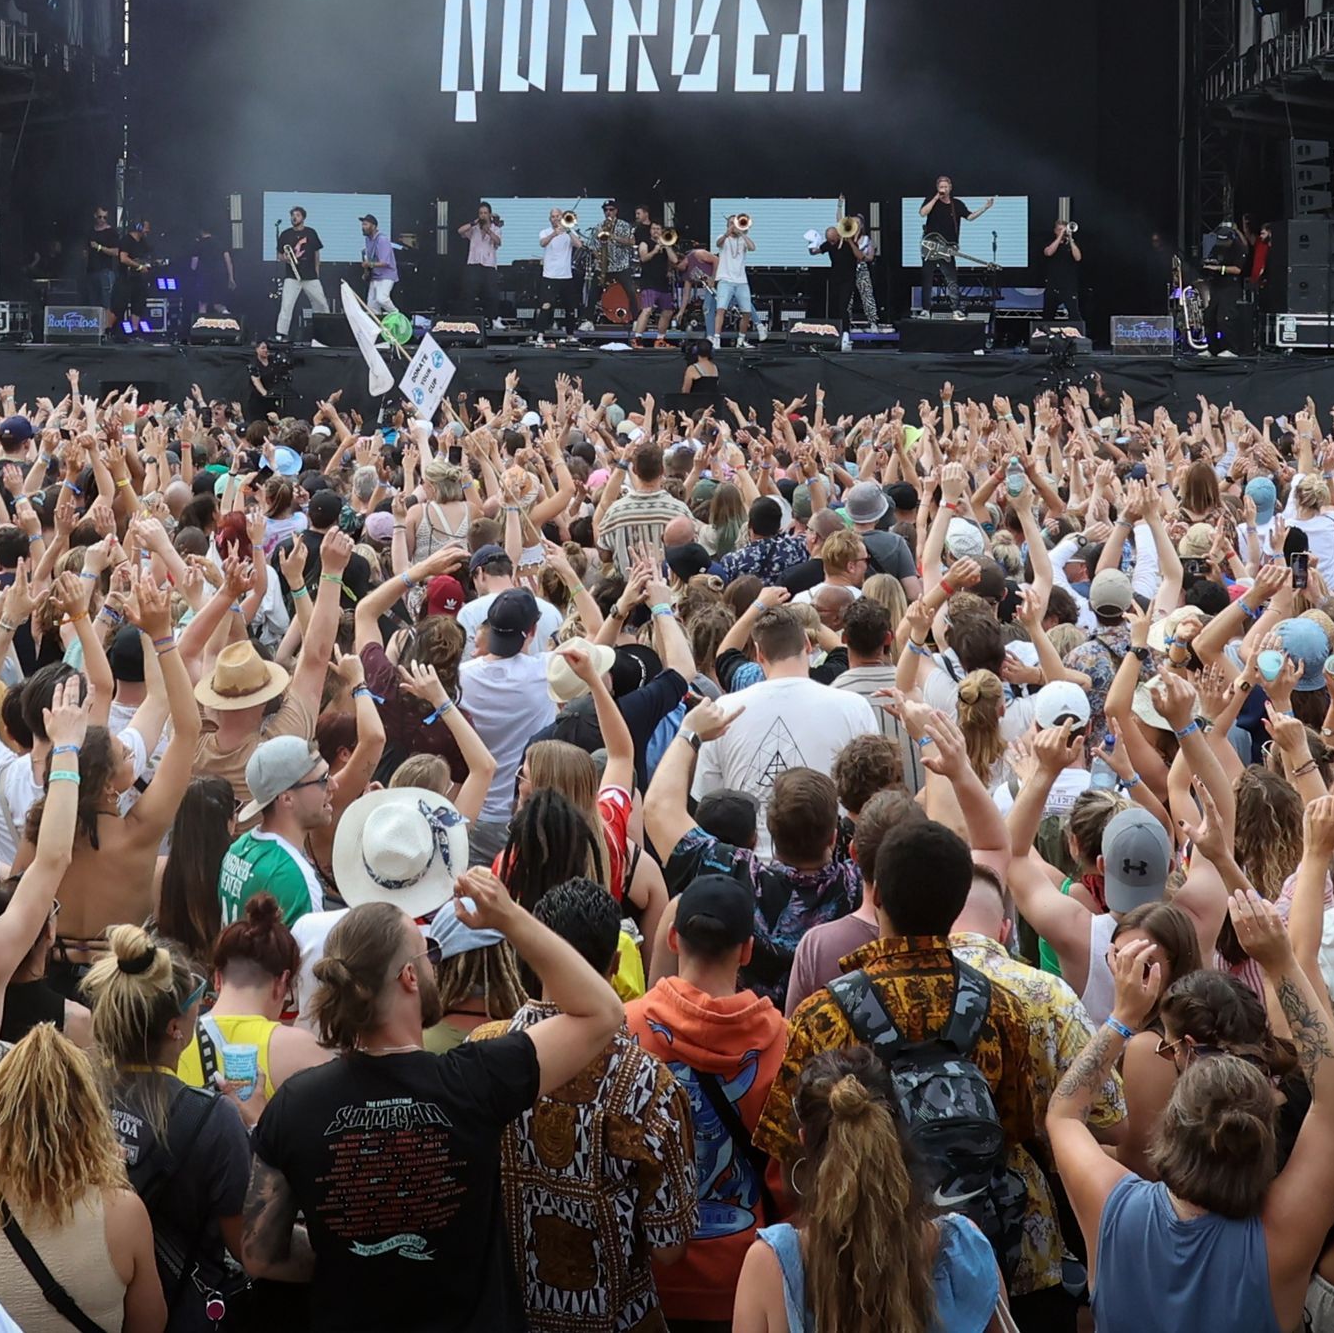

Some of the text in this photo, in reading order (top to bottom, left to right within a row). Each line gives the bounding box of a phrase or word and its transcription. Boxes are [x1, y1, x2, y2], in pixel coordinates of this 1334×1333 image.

[411, 353, 428, 383] DONATE
[420, 368, 432, 385] YOUR
[428, 378, 437, 394] CUP
[323, 1101, 454, 1136] SUMMERJAM
